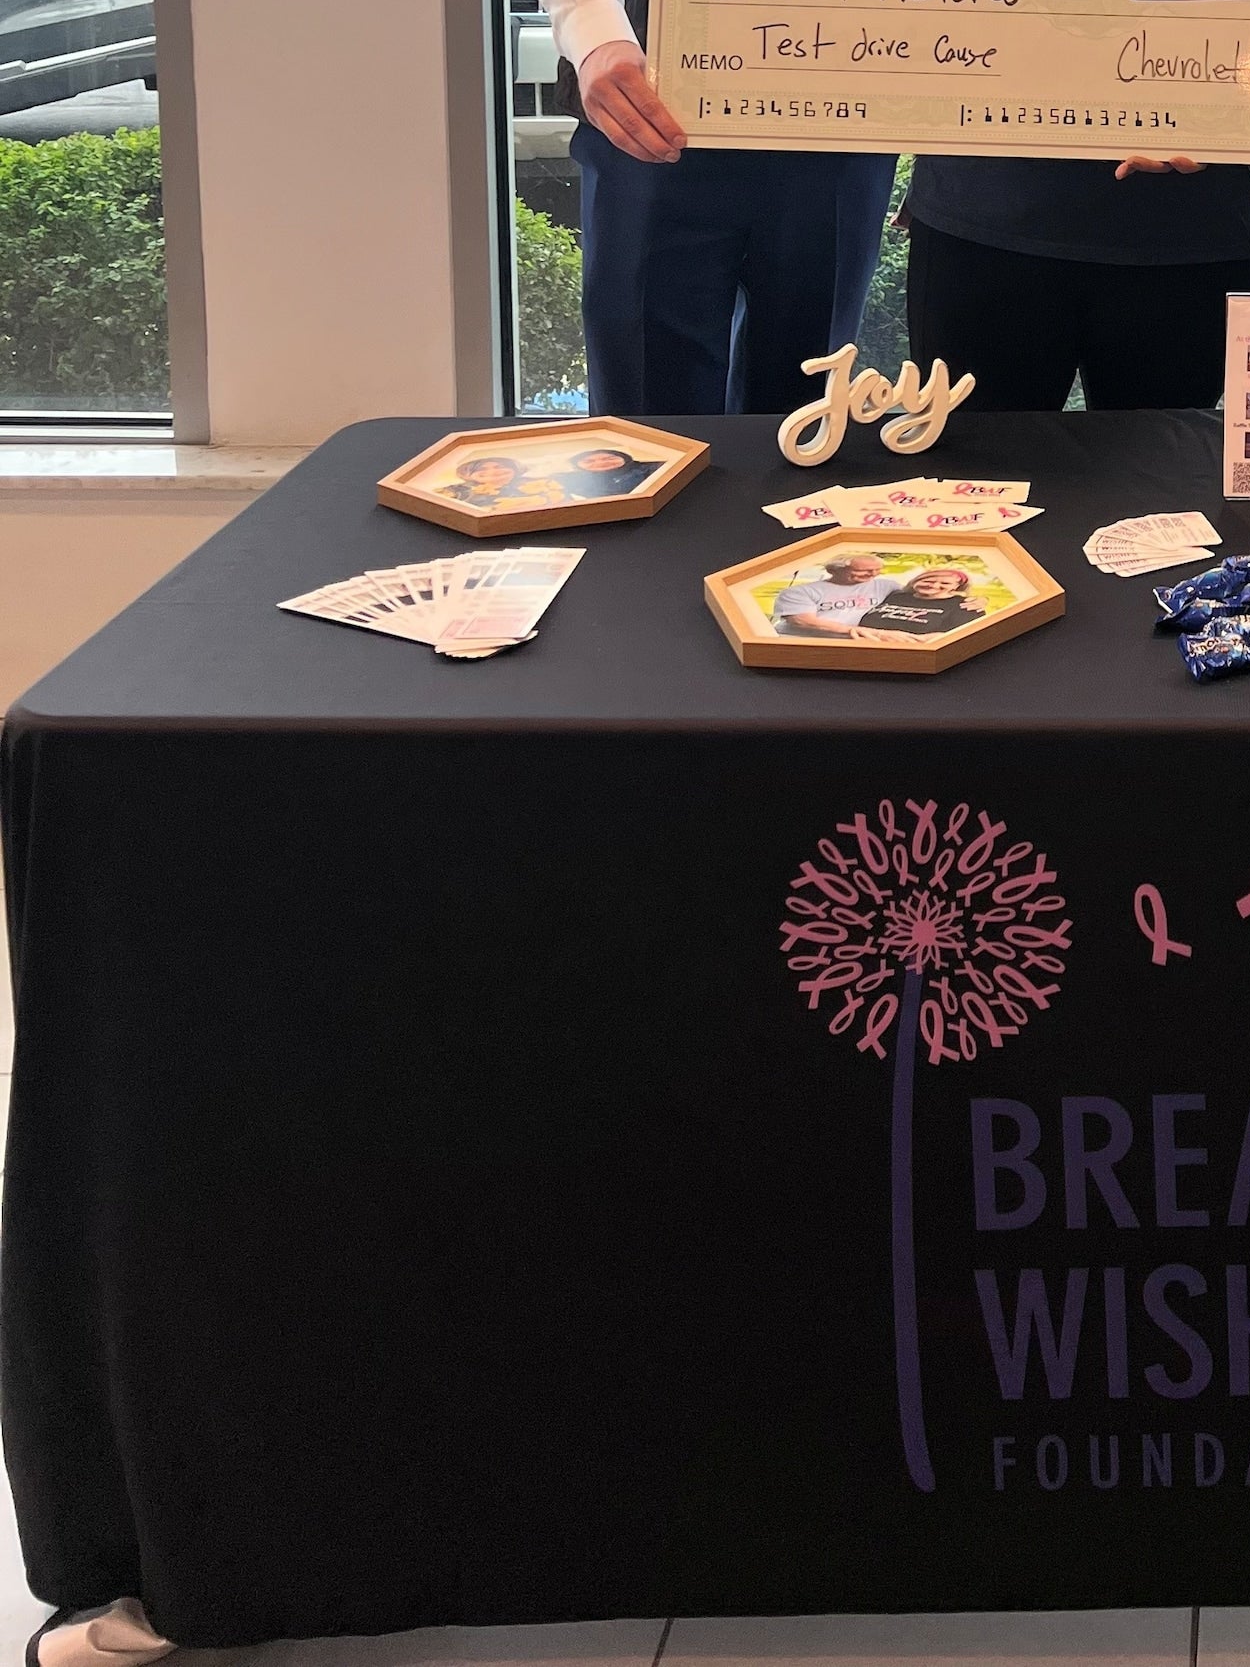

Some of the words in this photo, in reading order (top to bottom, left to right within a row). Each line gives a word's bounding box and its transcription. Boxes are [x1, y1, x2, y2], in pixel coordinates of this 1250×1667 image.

[681, 53, 743, 71] MEMO
[752, 22, 836, 61] Test
[851, 28, 911, 63] drive
[1117, 30, 1250, 83] Chevrolet
[778, 342, 976, 467] Joy
